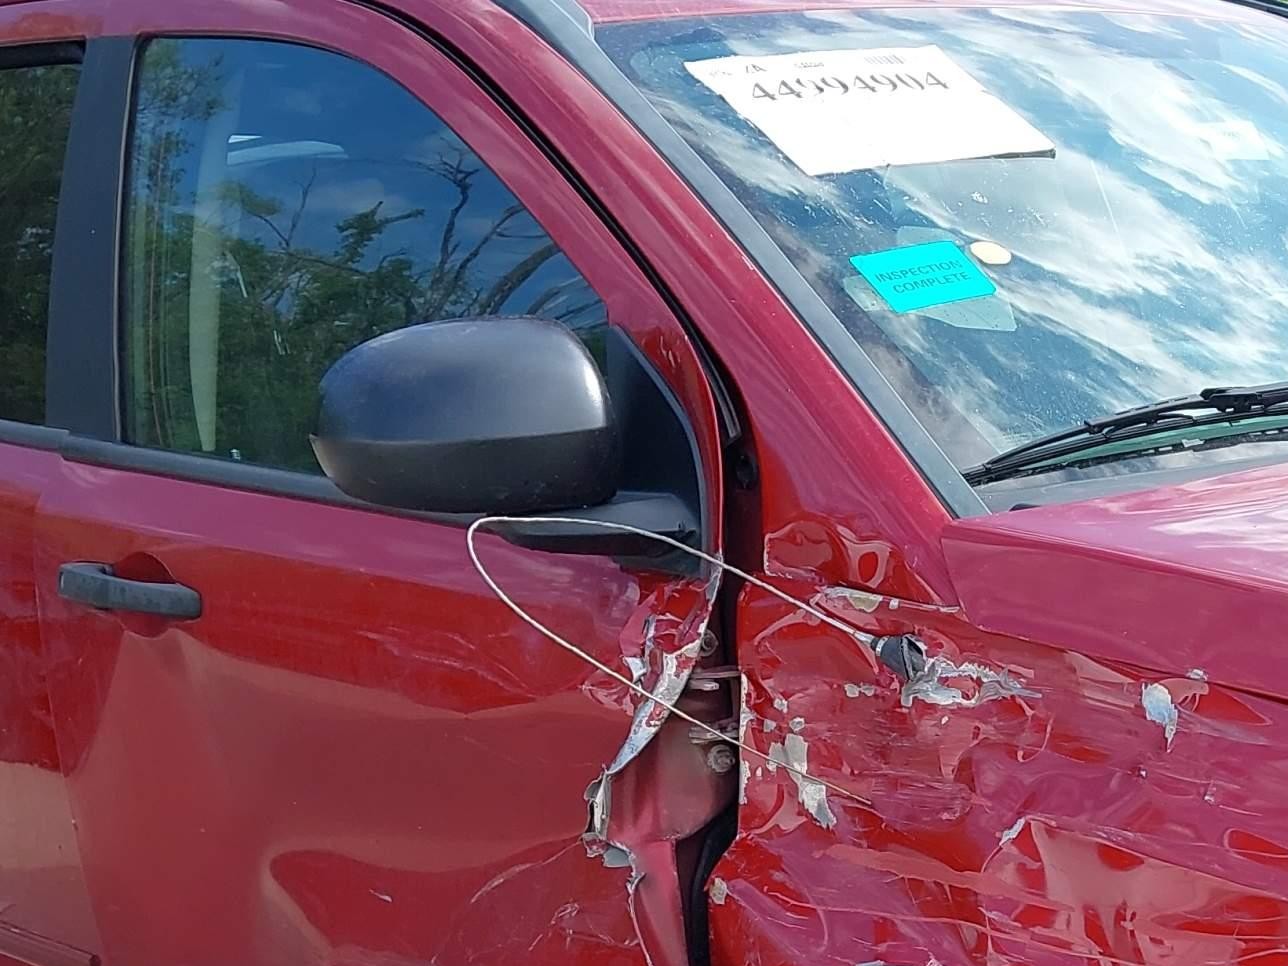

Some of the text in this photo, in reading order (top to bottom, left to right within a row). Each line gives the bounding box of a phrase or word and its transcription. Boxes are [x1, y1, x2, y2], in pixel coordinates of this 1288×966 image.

[752, 72, 949, 100] 44994904
[874, 259, 964, 283] INSPECTION
[892, 271, 971, 294] COMPLETE
